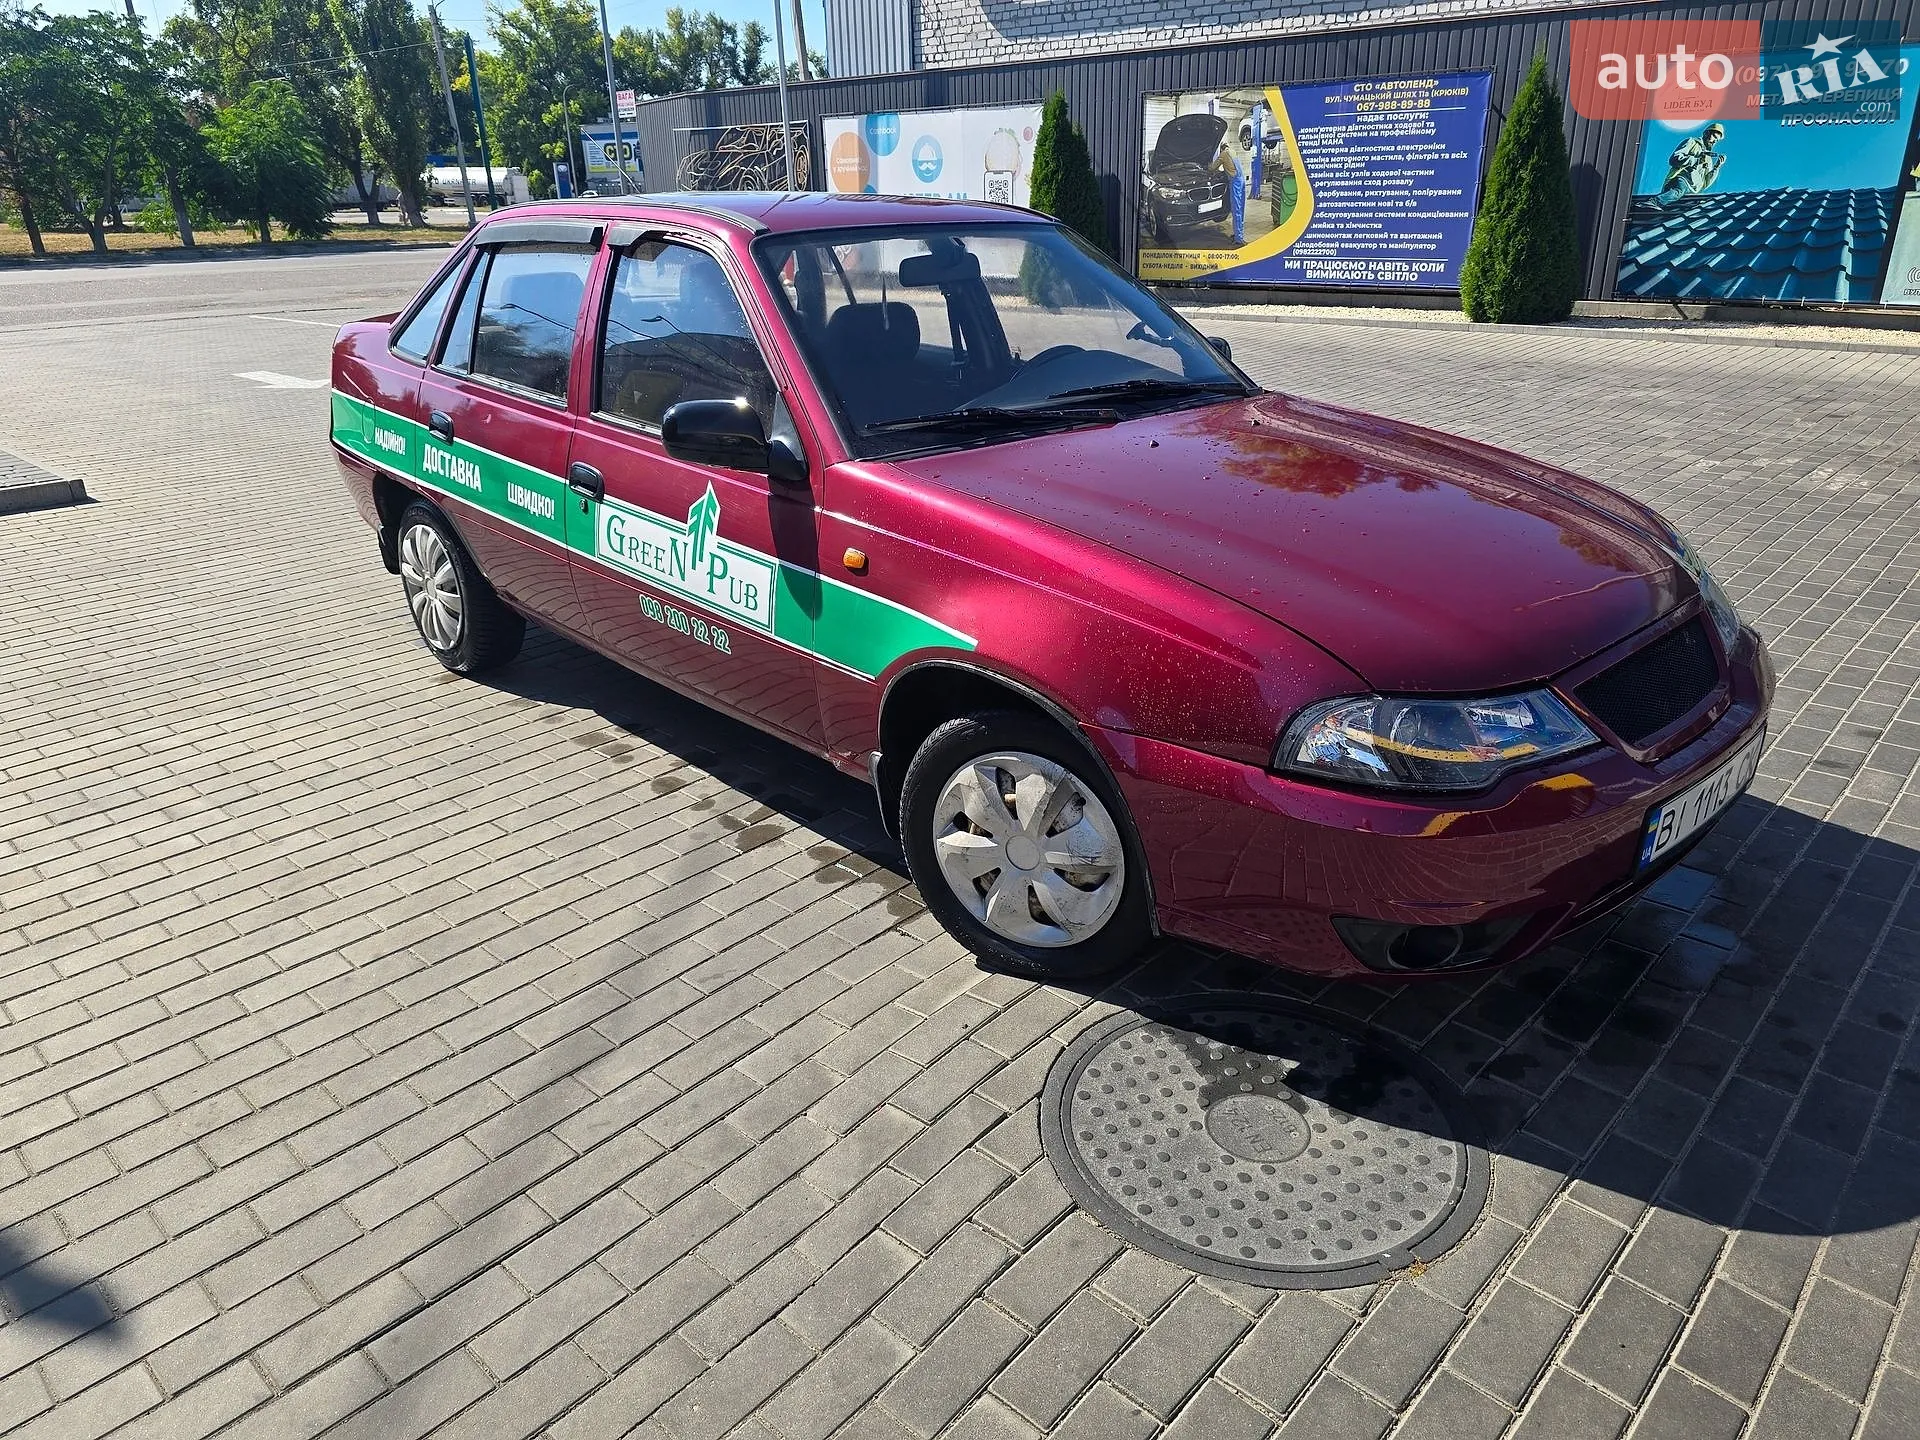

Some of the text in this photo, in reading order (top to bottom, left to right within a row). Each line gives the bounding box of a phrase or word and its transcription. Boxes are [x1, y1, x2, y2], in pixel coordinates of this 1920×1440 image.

[1354, 79, 1439, 92] СТО «АВТОЛЕНД»
[1343, 92, 1391, 102] ЧУМАЦЬКИЙ
[1393, 91, 1417, 99] ШЛЯХ
[1431, 87, 1469, 98] (КРЮКІВ)
[1356, 99, 1431, 112] 067-988-89-88
[1664, 100, 1691, 109] LIDER
[1356, 112, 1429, 123] надає послуги:
[1781, 110, 1896, 127] ПРОФНАСТИЛ
[1284, 261, 1445, 273] МИ ПРАЦЮЄМО НАВІТЬ КОЛИ
[1306, 270, 1418, 282] ВИМИКАЮТЬ СВІТЛО
[374, 426, 406, 456] НАДІЙНО!
[422, 443, 482, 492] ДОСТАВКА
[507, 482, 555, 520] ШВИДКО!
[639, 594, 732, 655] 098 200 22 22
[1655, 800, 1687, 852] BI
[1694, 766, 1734, 827] 1113
